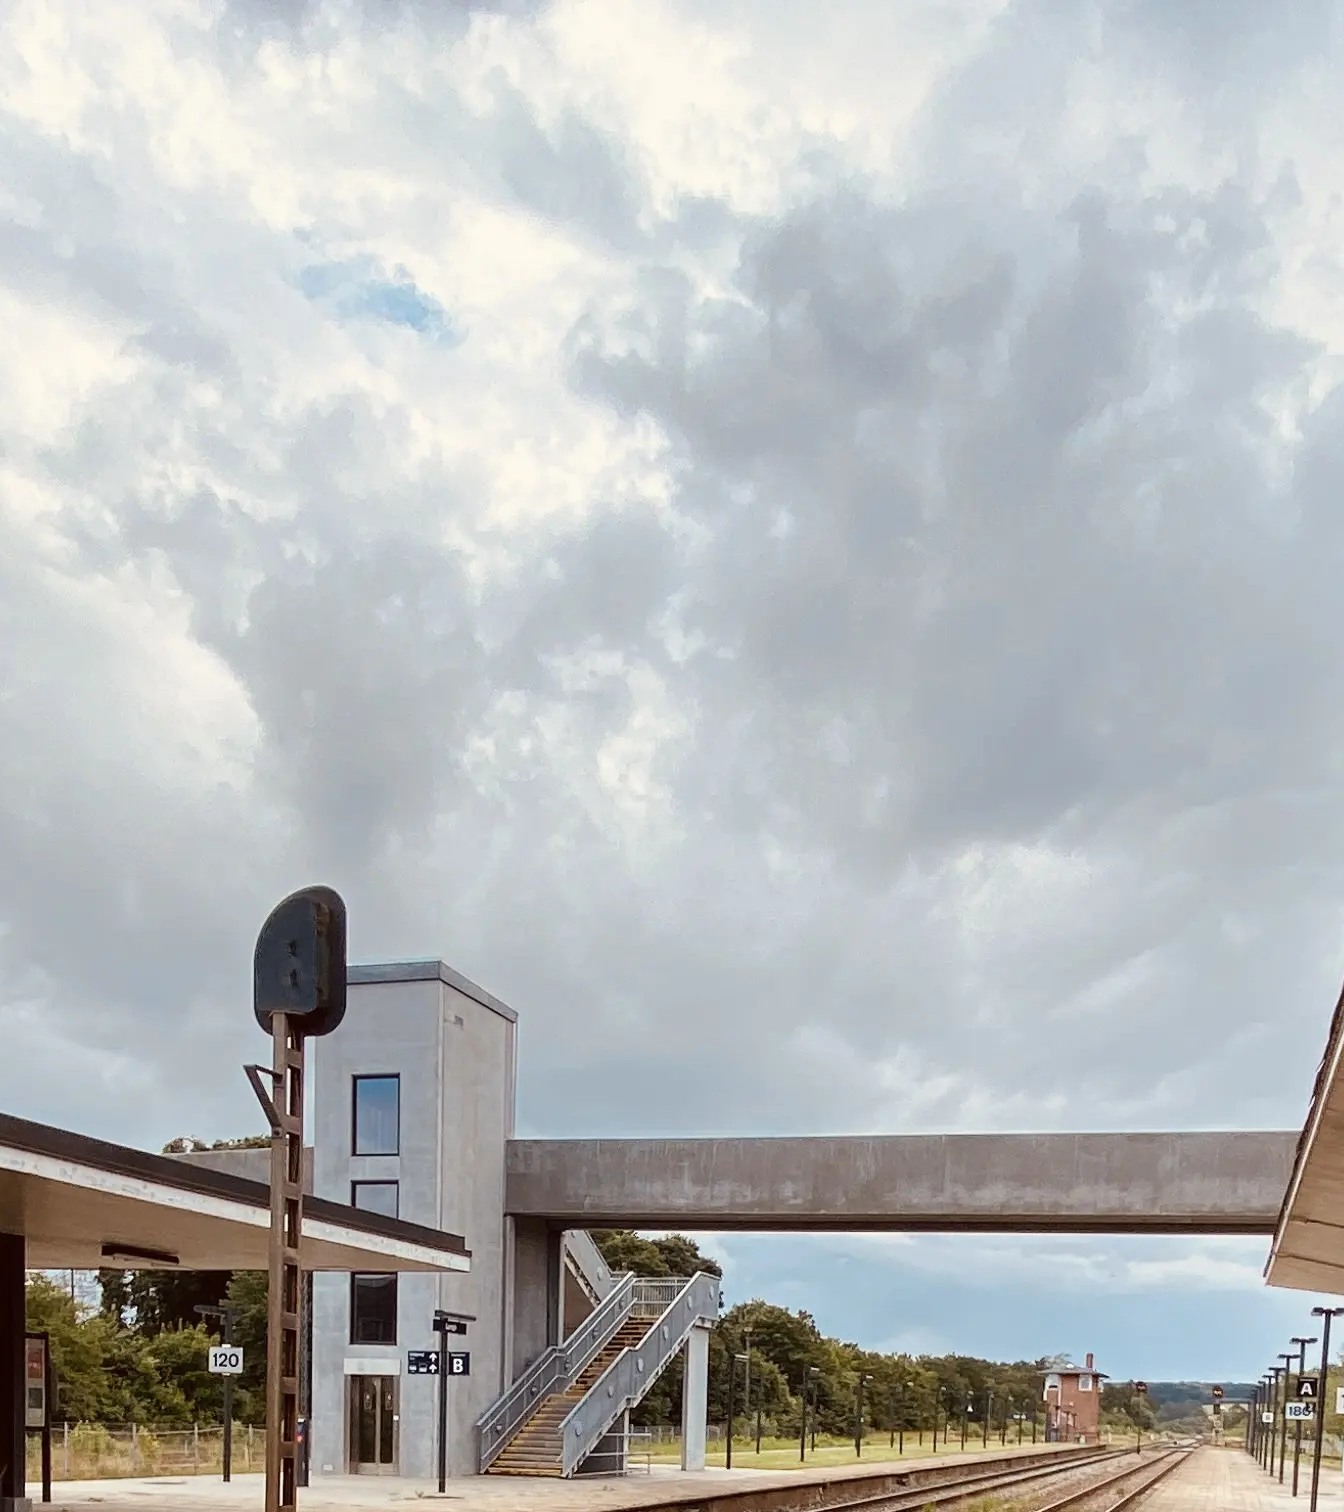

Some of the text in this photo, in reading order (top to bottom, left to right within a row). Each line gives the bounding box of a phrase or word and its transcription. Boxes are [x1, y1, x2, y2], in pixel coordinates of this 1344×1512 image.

[213, 1353, 239, 1367] 120
[453, 1358, 463, 1373] B
[1300, 1382, 1313, 1395] A
